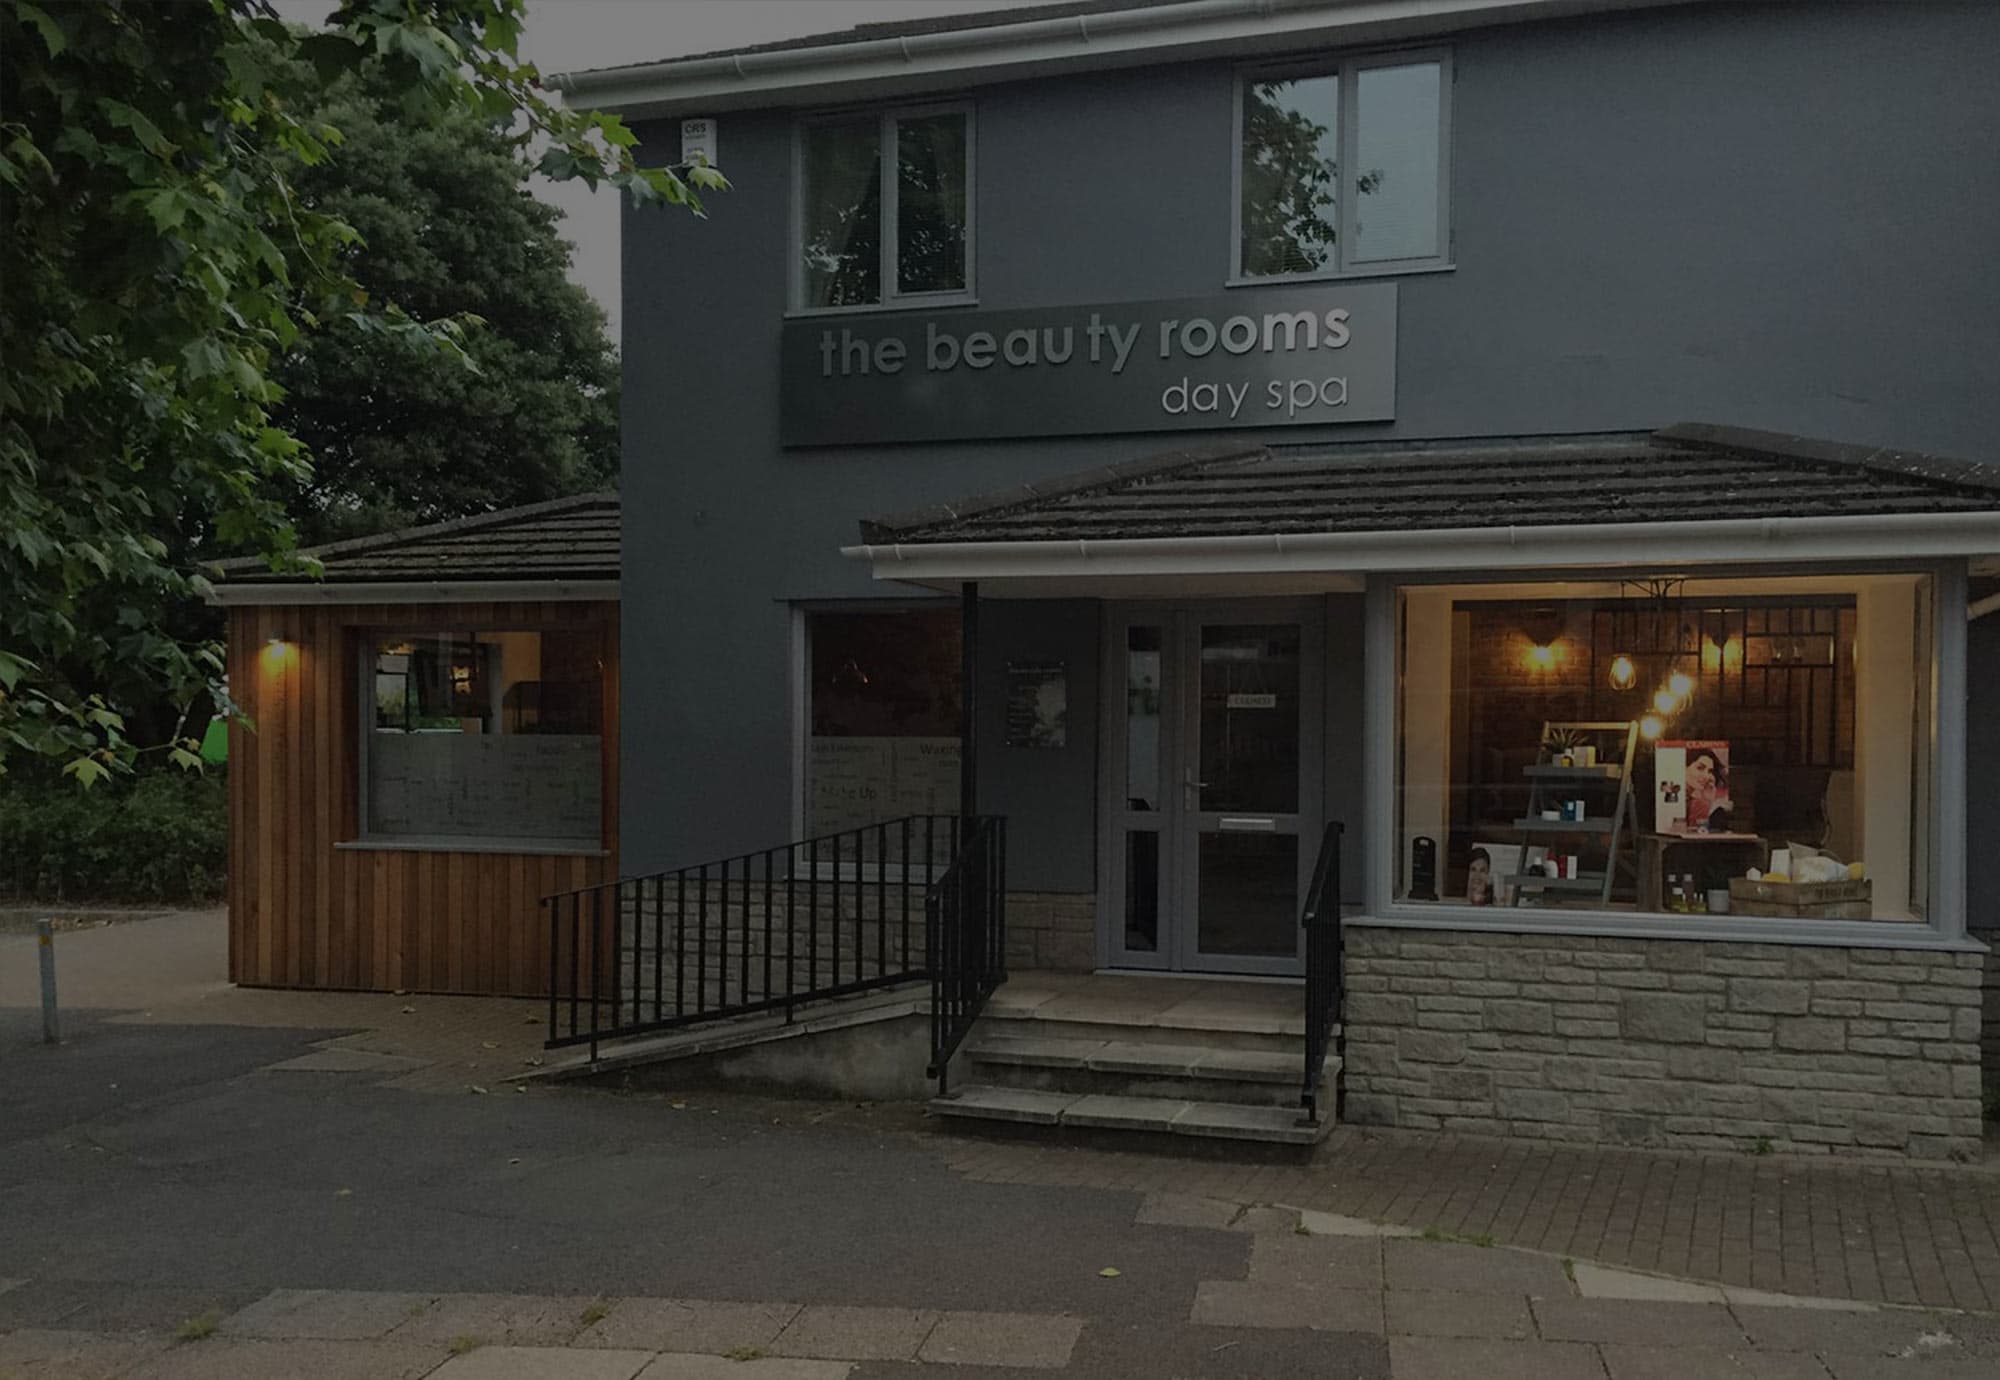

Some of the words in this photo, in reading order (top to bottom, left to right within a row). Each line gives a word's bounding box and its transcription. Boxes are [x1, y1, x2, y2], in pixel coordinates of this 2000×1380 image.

[820, 328, 907, 377] the
[926, 313, 1142, 373] beauty
[1159, 307, 1351, 358] rooms
[1161, 377, 1250, 418] day
[1266, 375, 1349, 416] spa
